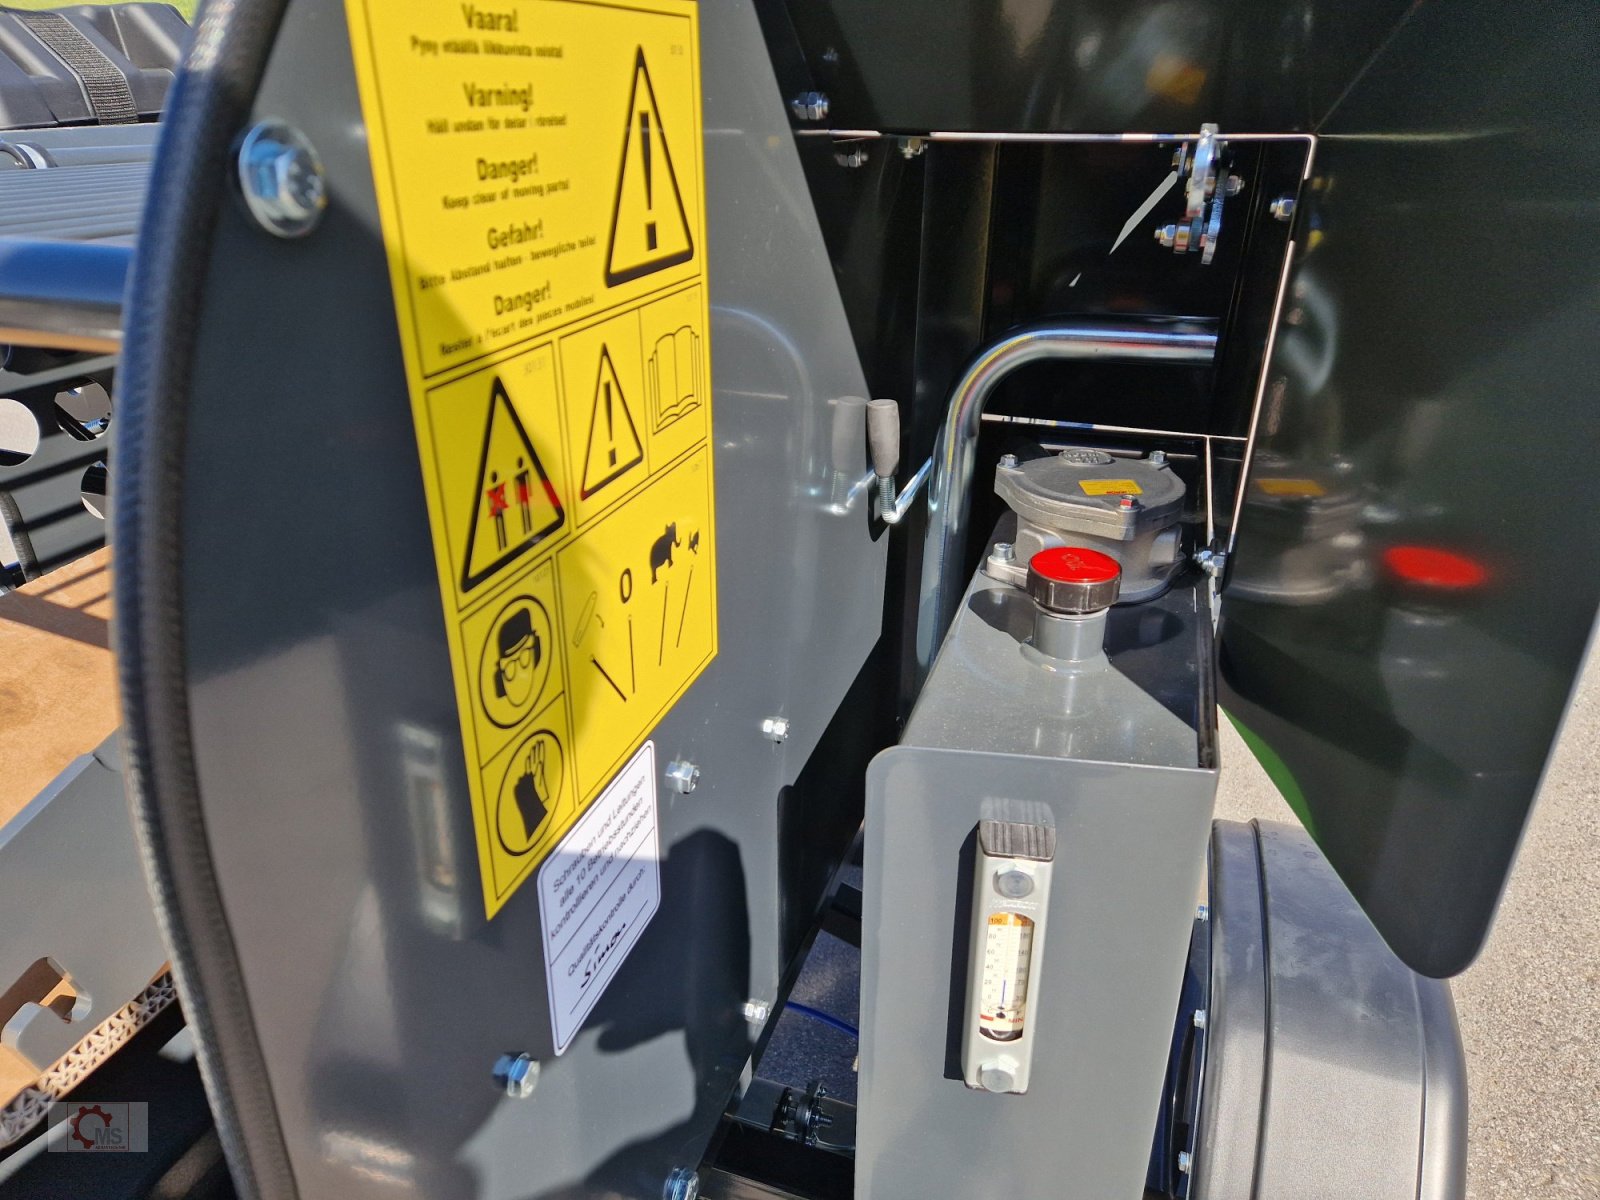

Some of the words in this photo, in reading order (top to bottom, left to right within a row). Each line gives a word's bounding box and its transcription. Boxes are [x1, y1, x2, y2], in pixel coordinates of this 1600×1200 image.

[462, 3, 519, 32] Vaara!
[462, 82, 534, 112] Varning!
[476, 152, 539, 183] Danger!
[442, 196, 469, 210] Keep
[472, 191, 497, 205] clear
[513, 183, 544, 198] moving
[487, 219, 544, 250] Gefahr!
[419, 275, 445, 290] Bitte
[451, 263, 491, 281] Abstand
[494, 280, 551, 316] Danger!
[553, 836, 597, 892] Schrauben
[597, 813, 611, 838] und
[612, 775, 645, 820] Leitungen
[559, 884, 575, 907] alle
[576, 868, 587, 885] 10
[587, 797, 643, 871] Betriebsstunden
[550, 874, 599, 940] kontrollieren
[599, 852, 614, 877] und
[614, 805, 652, 858] nachziehen
[567, 893, 627, 976] Qualitätskontrolle
[627, 865, 646, 895] durch:
